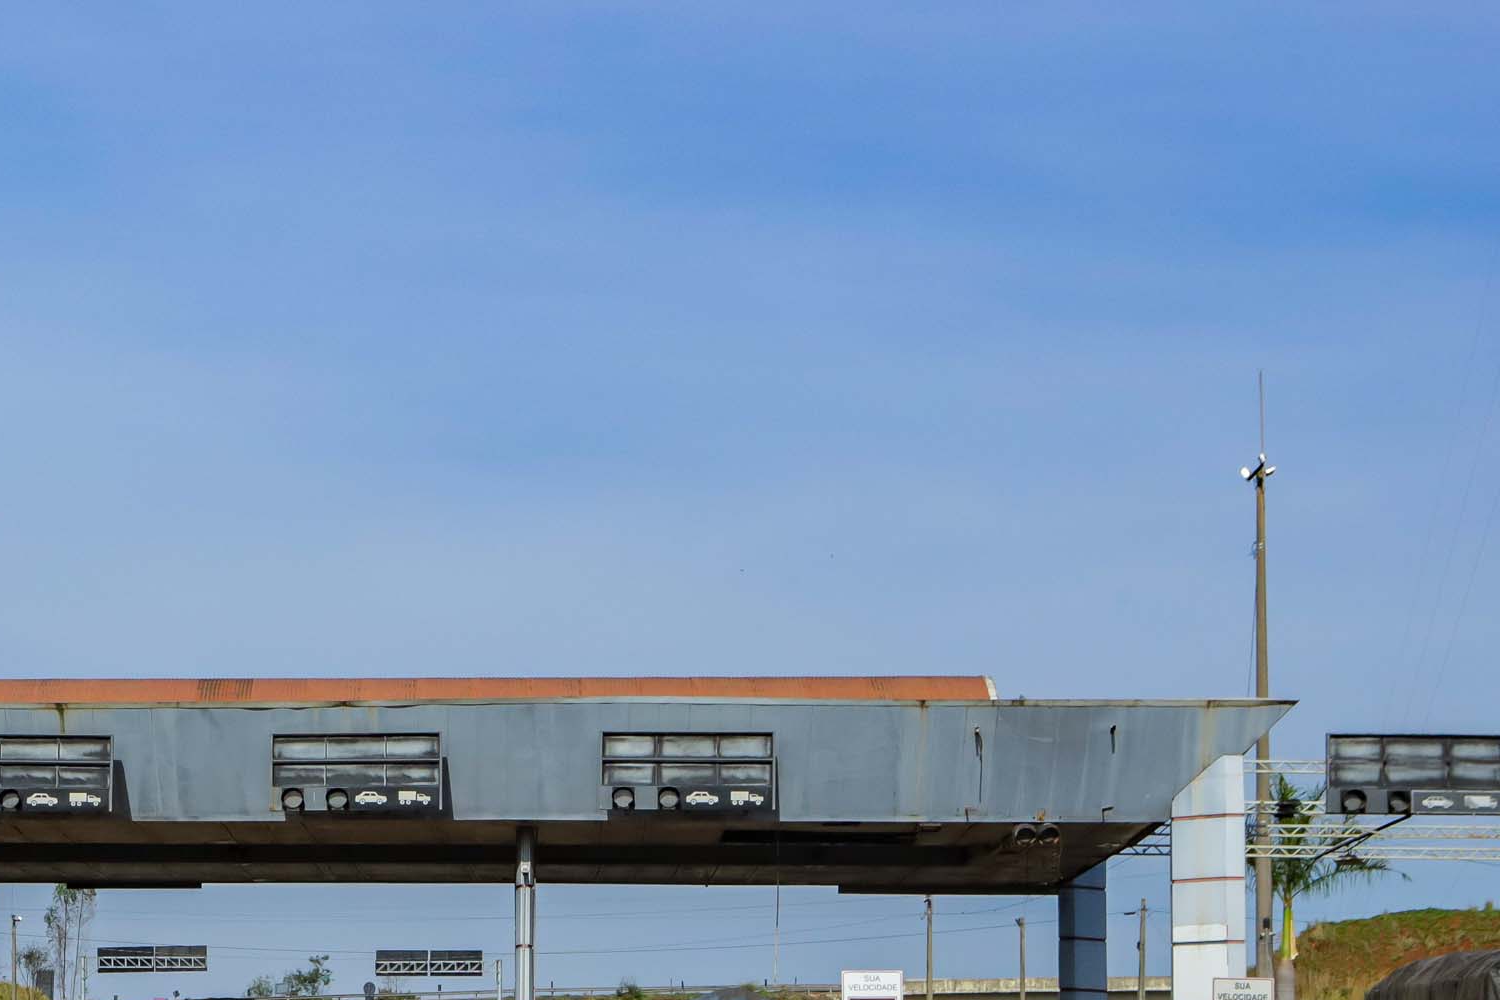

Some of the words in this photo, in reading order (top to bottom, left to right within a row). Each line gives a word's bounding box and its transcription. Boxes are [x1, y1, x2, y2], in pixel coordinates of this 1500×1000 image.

[864, 975, 881, 983] SUA
[1234, 982, 1251, 990] SUA
[1218, 993, 1268, 1000] VELOCIDADE
